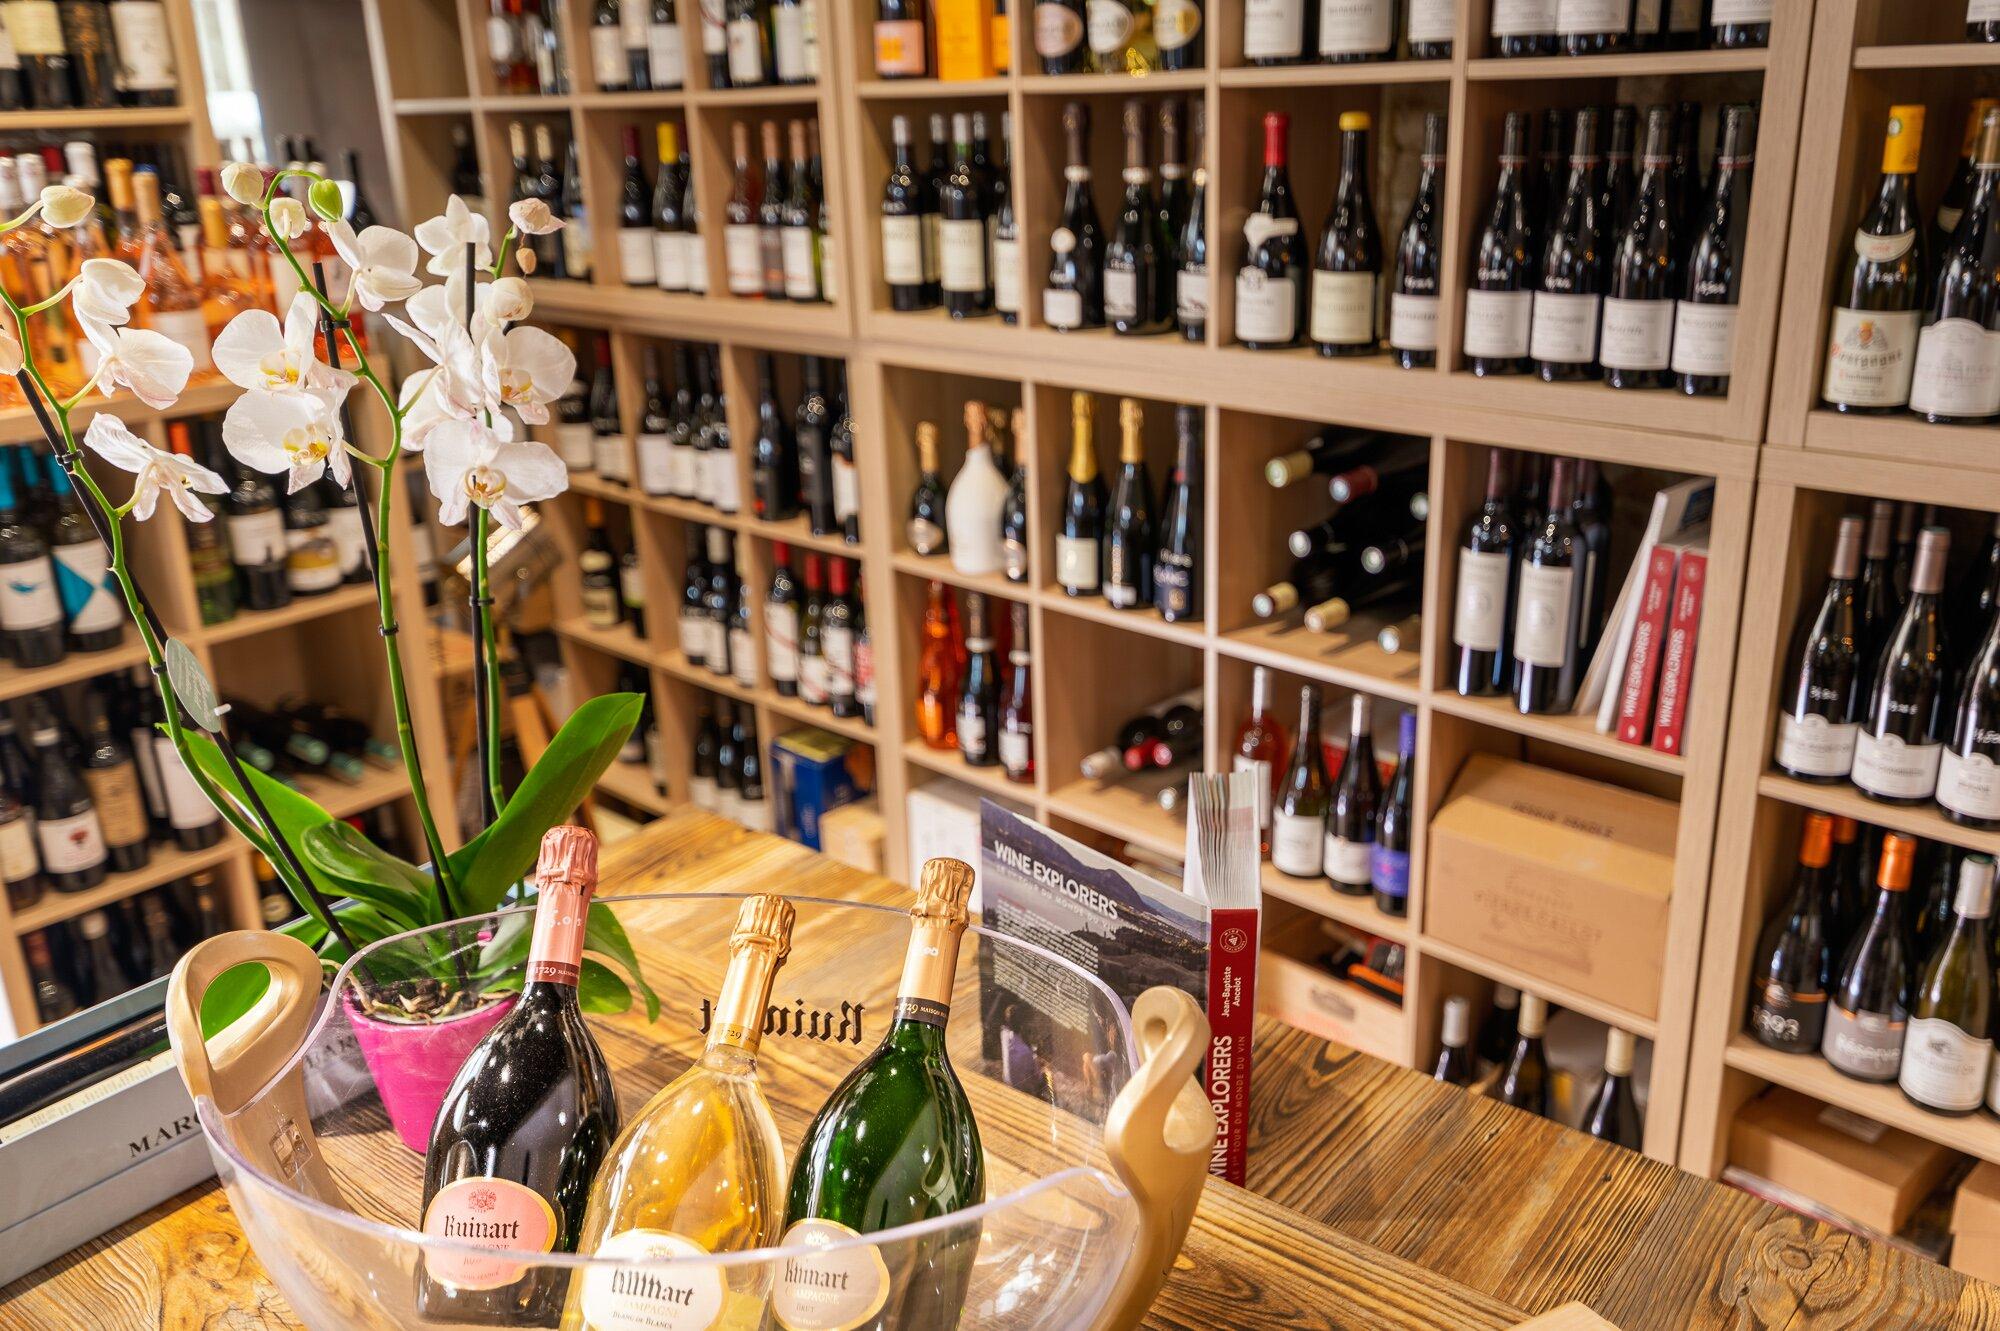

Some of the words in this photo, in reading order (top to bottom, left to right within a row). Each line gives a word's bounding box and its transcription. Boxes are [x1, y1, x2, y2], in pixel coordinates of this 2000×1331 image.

[994, 839, 1032, 876] WINE
[1033, 862, 1119, 920] EXPLORERS
[1055, 896, 1085, 917] MONDE
[1221, 966, 1232, 1018] Jean-Baptiste
[1232, 976, 1242, 1007] Ancelot
[1237, 1036, 1246, 1053] VIN
[1236, 1057, 1245, 1070] DU
[1211, 1035, 1233, 1135] EXPLORERS
[1235, 1074, 1245, 1108] MONDE
[1234, 1111, 1243, 1124] DU
[444, 1214, 520, 1240] Ruinart
[645, 1316, 674, 1330] BLANCS
